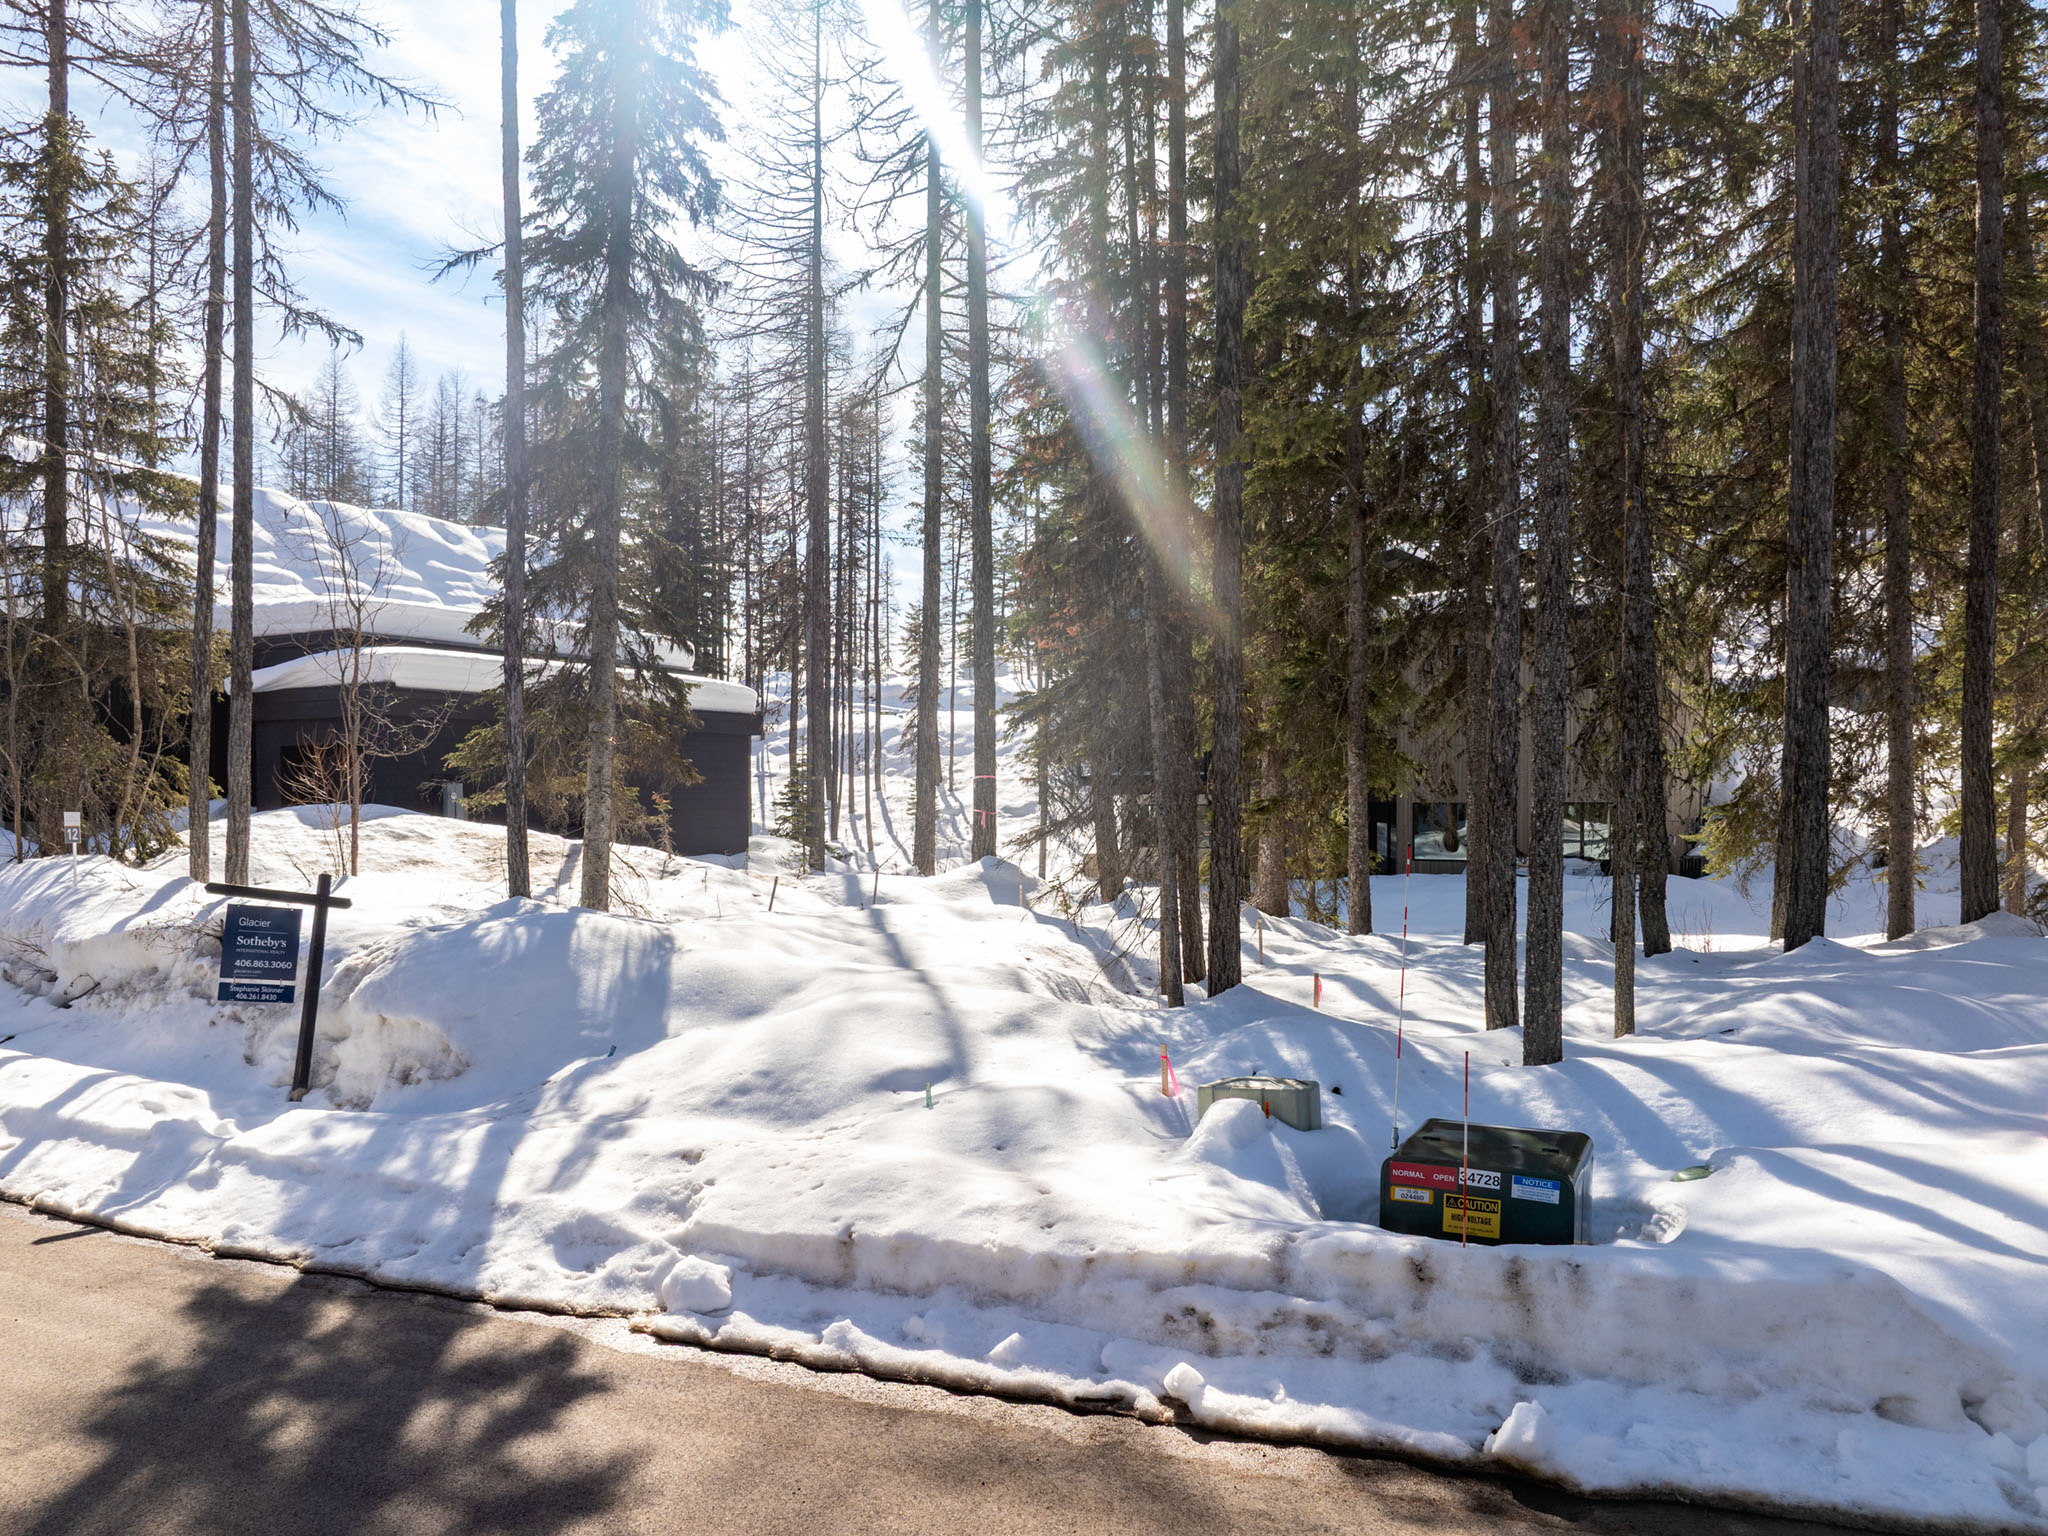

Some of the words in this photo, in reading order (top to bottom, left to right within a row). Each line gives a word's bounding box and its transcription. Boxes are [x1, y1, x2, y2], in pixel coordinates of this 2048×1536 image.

[67, 828, 78, 841] 12
[239, 917, 271, 927] Glacier
[236, 936, 286, 949] Sotheby's
[235, 959, 292, 969] 406.863.3060
[229, 985, 260, 993] Stephanie
[261, 986, 284, 994] Skinner
[1392, 1169, 1425, 1179] NORMAL
[1433, 1173, 1455, 1182] OPEN
[1459, 1172, 1500, 1187] 34728
[1522, 1178, 1553, 1189] NOTICE
[1457, 1199, 1498, 1212] CAUTION
[1467, 1216, 1492, 1226] VOLTAGE
